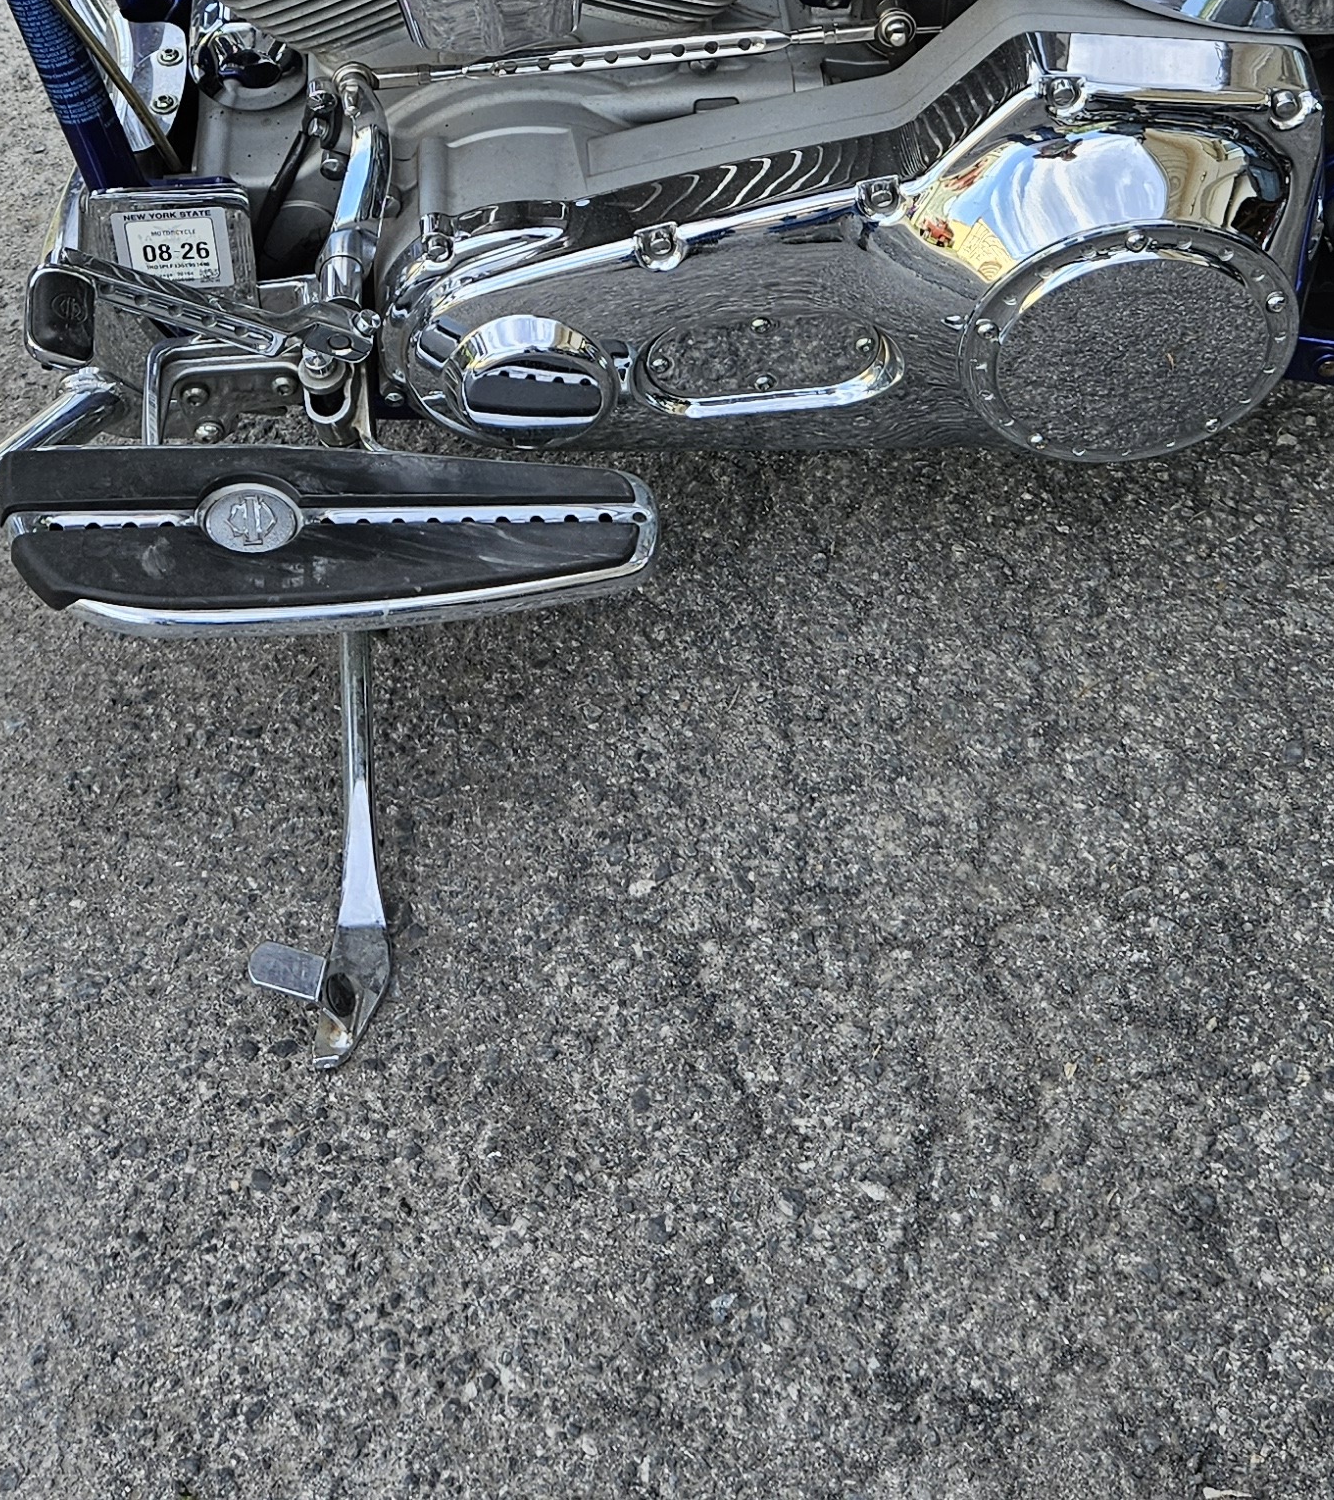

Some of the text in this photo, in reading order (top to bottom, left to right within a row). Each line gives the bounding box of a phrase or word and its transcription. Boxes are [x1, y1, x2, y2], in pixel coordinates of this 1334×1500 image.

[123, 209, 212, 222] NEW YORK STATE
